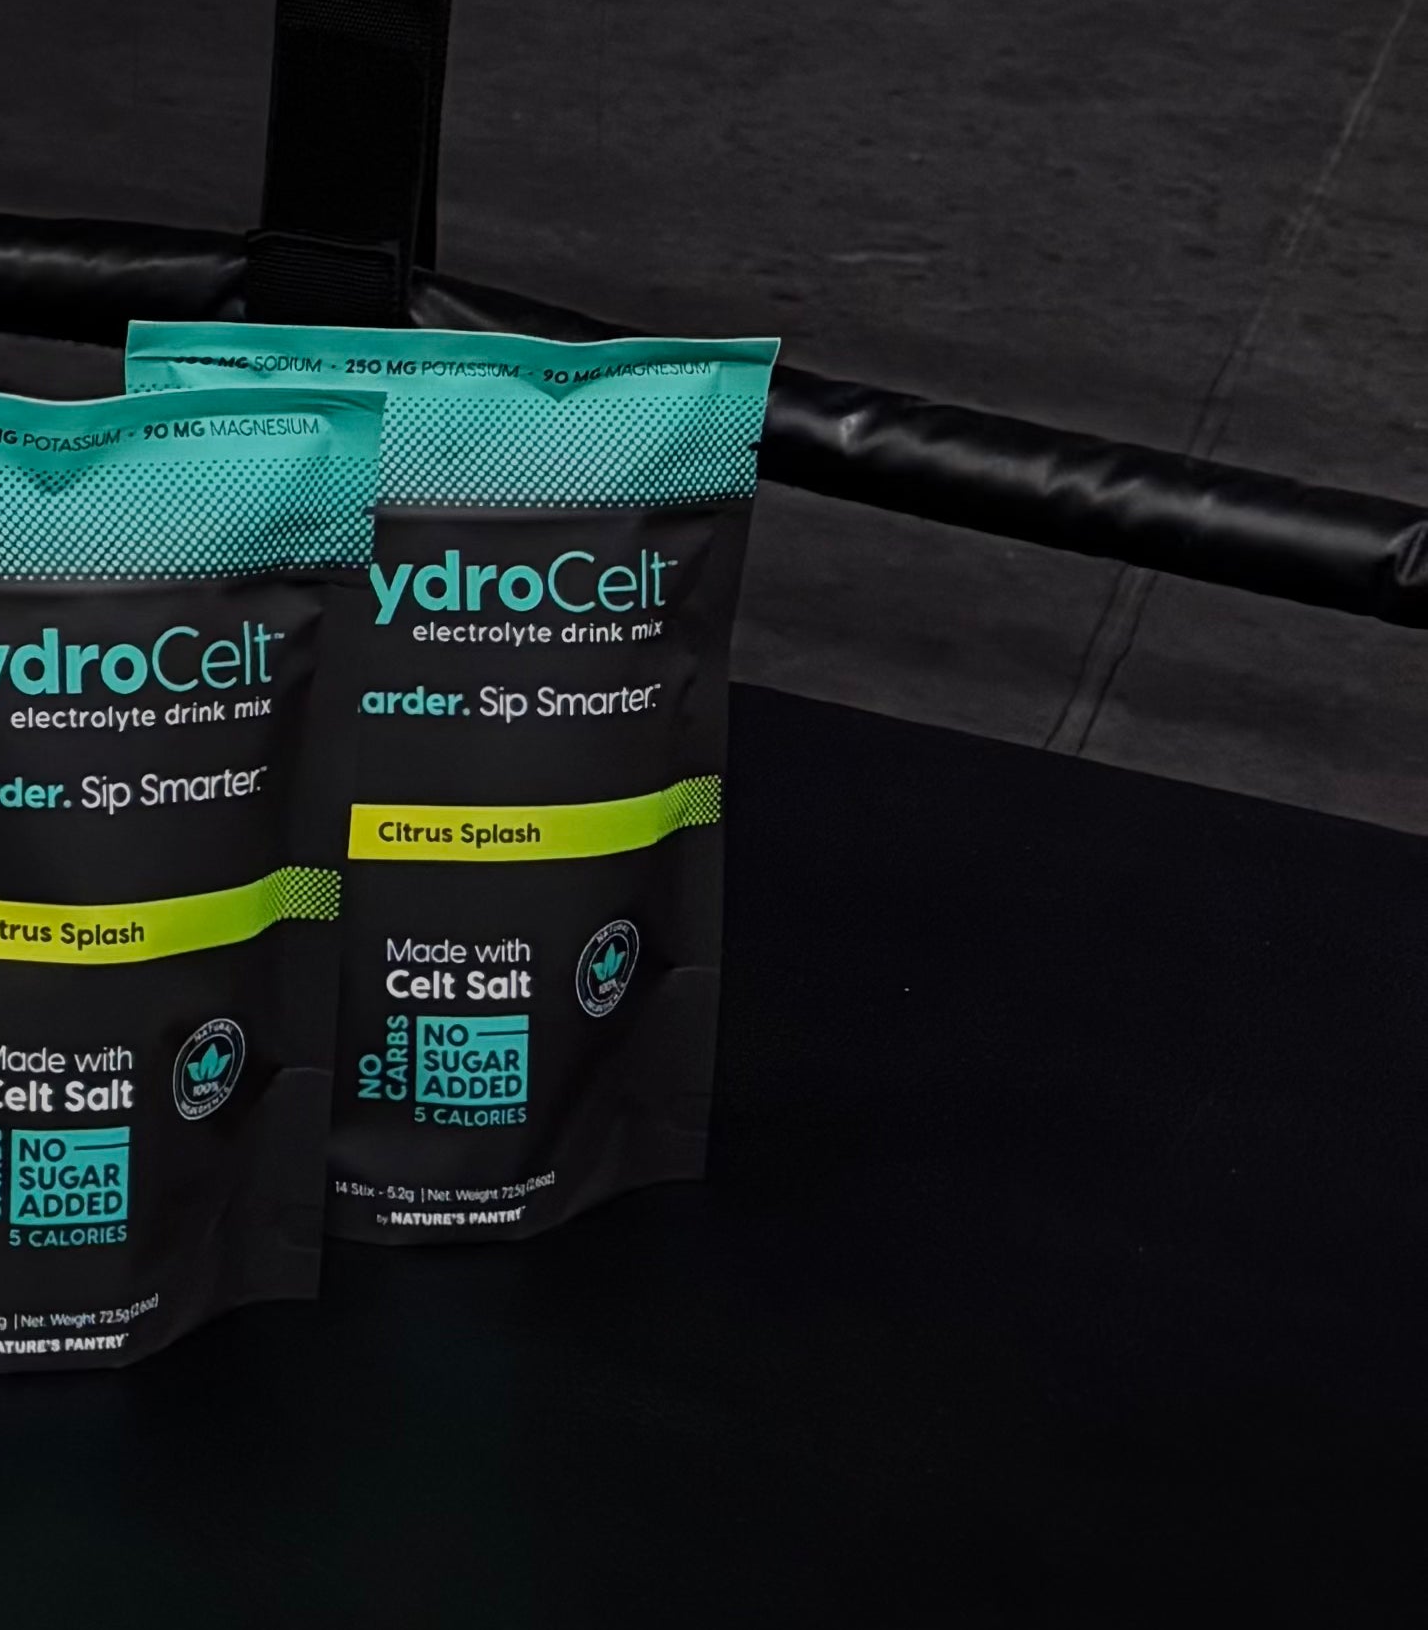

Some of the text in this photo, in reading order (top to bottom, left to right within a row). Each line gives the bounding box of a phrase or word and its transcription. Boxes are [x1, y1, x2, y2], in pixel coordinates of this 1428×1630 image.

[253, 355, 322, 373] SODIUM
[345, 359, 381, 376] 250
[387, 360, 417, 376] MG
[422, 359, 519, 379] POTASSIUM
[543, 368, 568, 386] 90
[572, 367, 601, 383] MG
[604, 360, 712, 379] MAGNESIUM
[22, 429, 121, 454] POTASSIUM
[144, 423, 169, 441] 90
[172, 418, 207, 438] MG
[209, 416, 319, 437] MAGNESIUM
[413, 621, 662, 647] electrolyte drink mix
[11, 697, 271, 732] electrolyte drink mix
[362, 686, 470, 715] arder.
[480, 686, 527, 723] Sip
[82, 776, 131, 815] Sip
[379, 822, 540, 848] Citrus Splash
[61, 922, 144, 950] Splash
[387, 938, 530, 963] Made with
[386, 970, 531, 999] Celt Salt
[424, 1024, 468, 1046] NO
[74, 1046, 132, 1072] with
[386, 1015, 409, 1100] CARBS
[424, 1049, 519, 1073] SUGAR
[358, 1054, 382, 1098] NO
[423, 1075, 522, 1099] ADDED
[65, 1079, 133, 1112] Salt
[415, 1107, 526, 1126] 5 CALORIES
[19, 1138, 66, 1162] NO
[19, 1164, 120, 1190] SUGAR
[18, 1191, 122, 1218] ADDED
[352, 1183, 374, 1197] Stix
[456, 1189, 498, 1203] Weight
[391, 1212, 465, 1225] NATURE'S
[9, 1225, 126, 1247] 5 CALORIES
[50, 1313, 96, 1328] Weight
